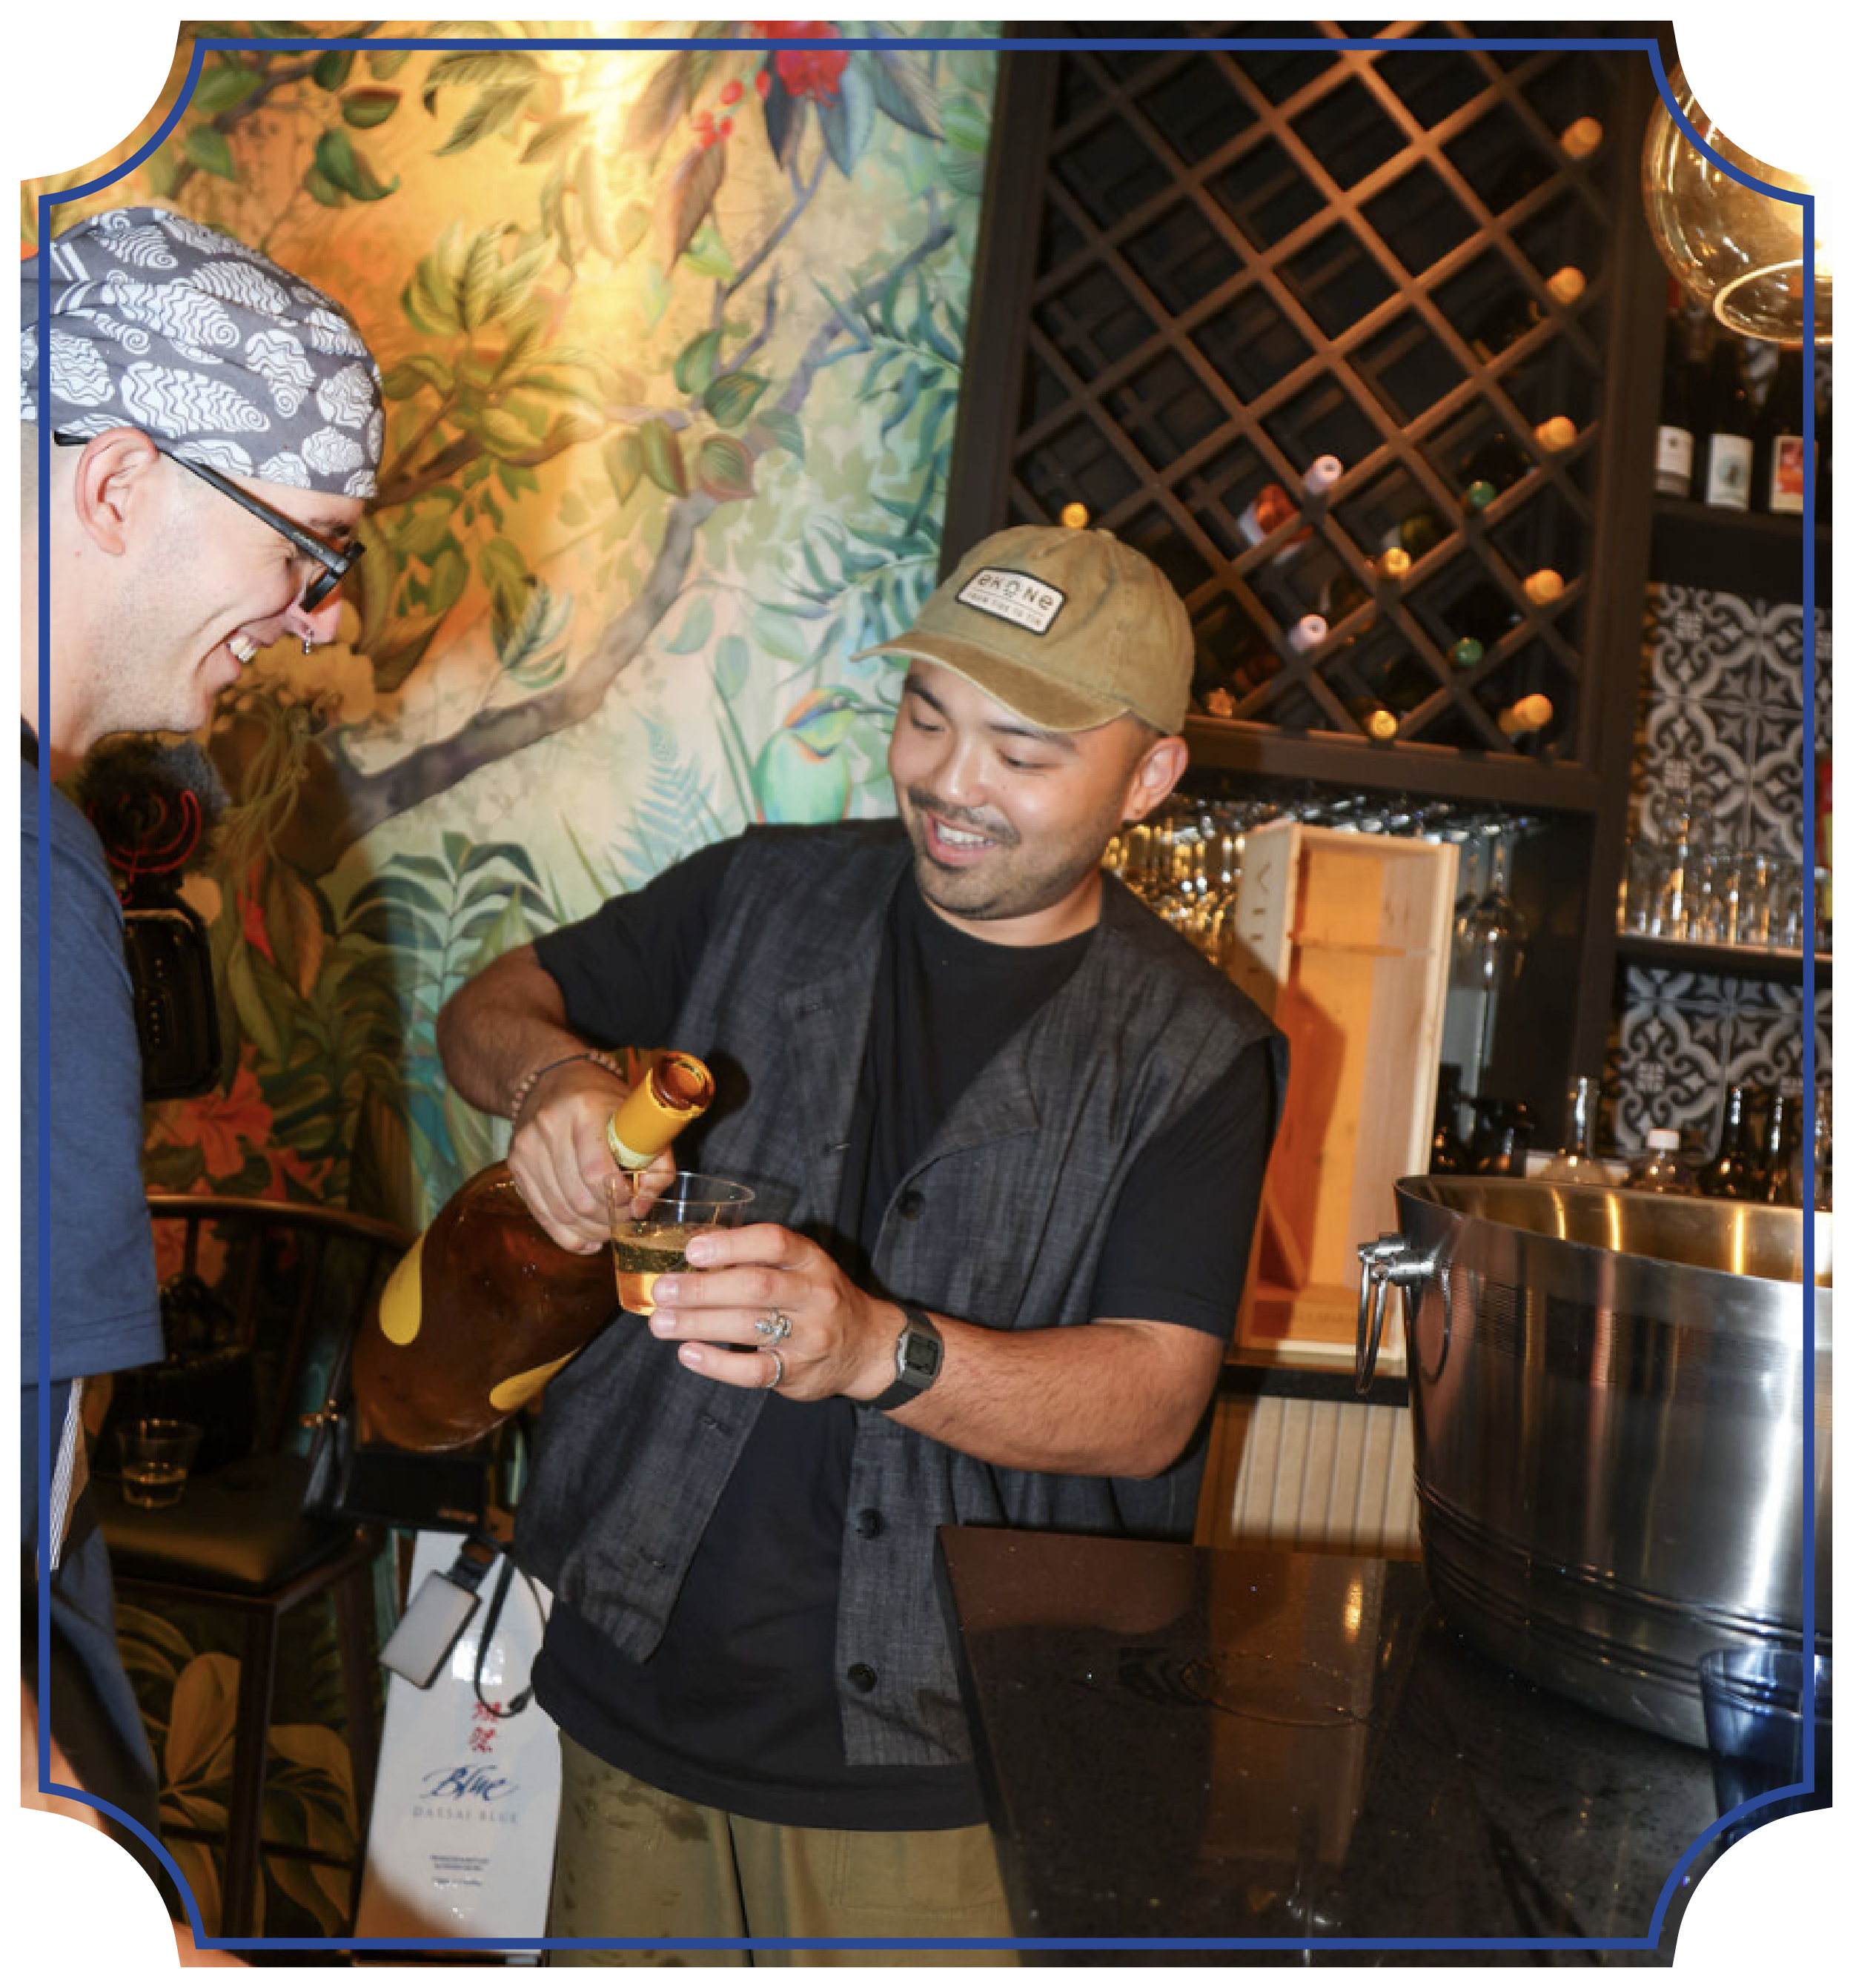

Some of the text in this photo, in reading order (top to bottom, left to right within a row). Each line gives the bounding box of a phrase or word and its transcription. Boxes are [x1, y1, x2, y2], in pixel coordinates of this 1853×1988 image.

[420, 1763, 520, 1801] Blue
[412, 1806, 519, 1823] DASSAI BLUE
